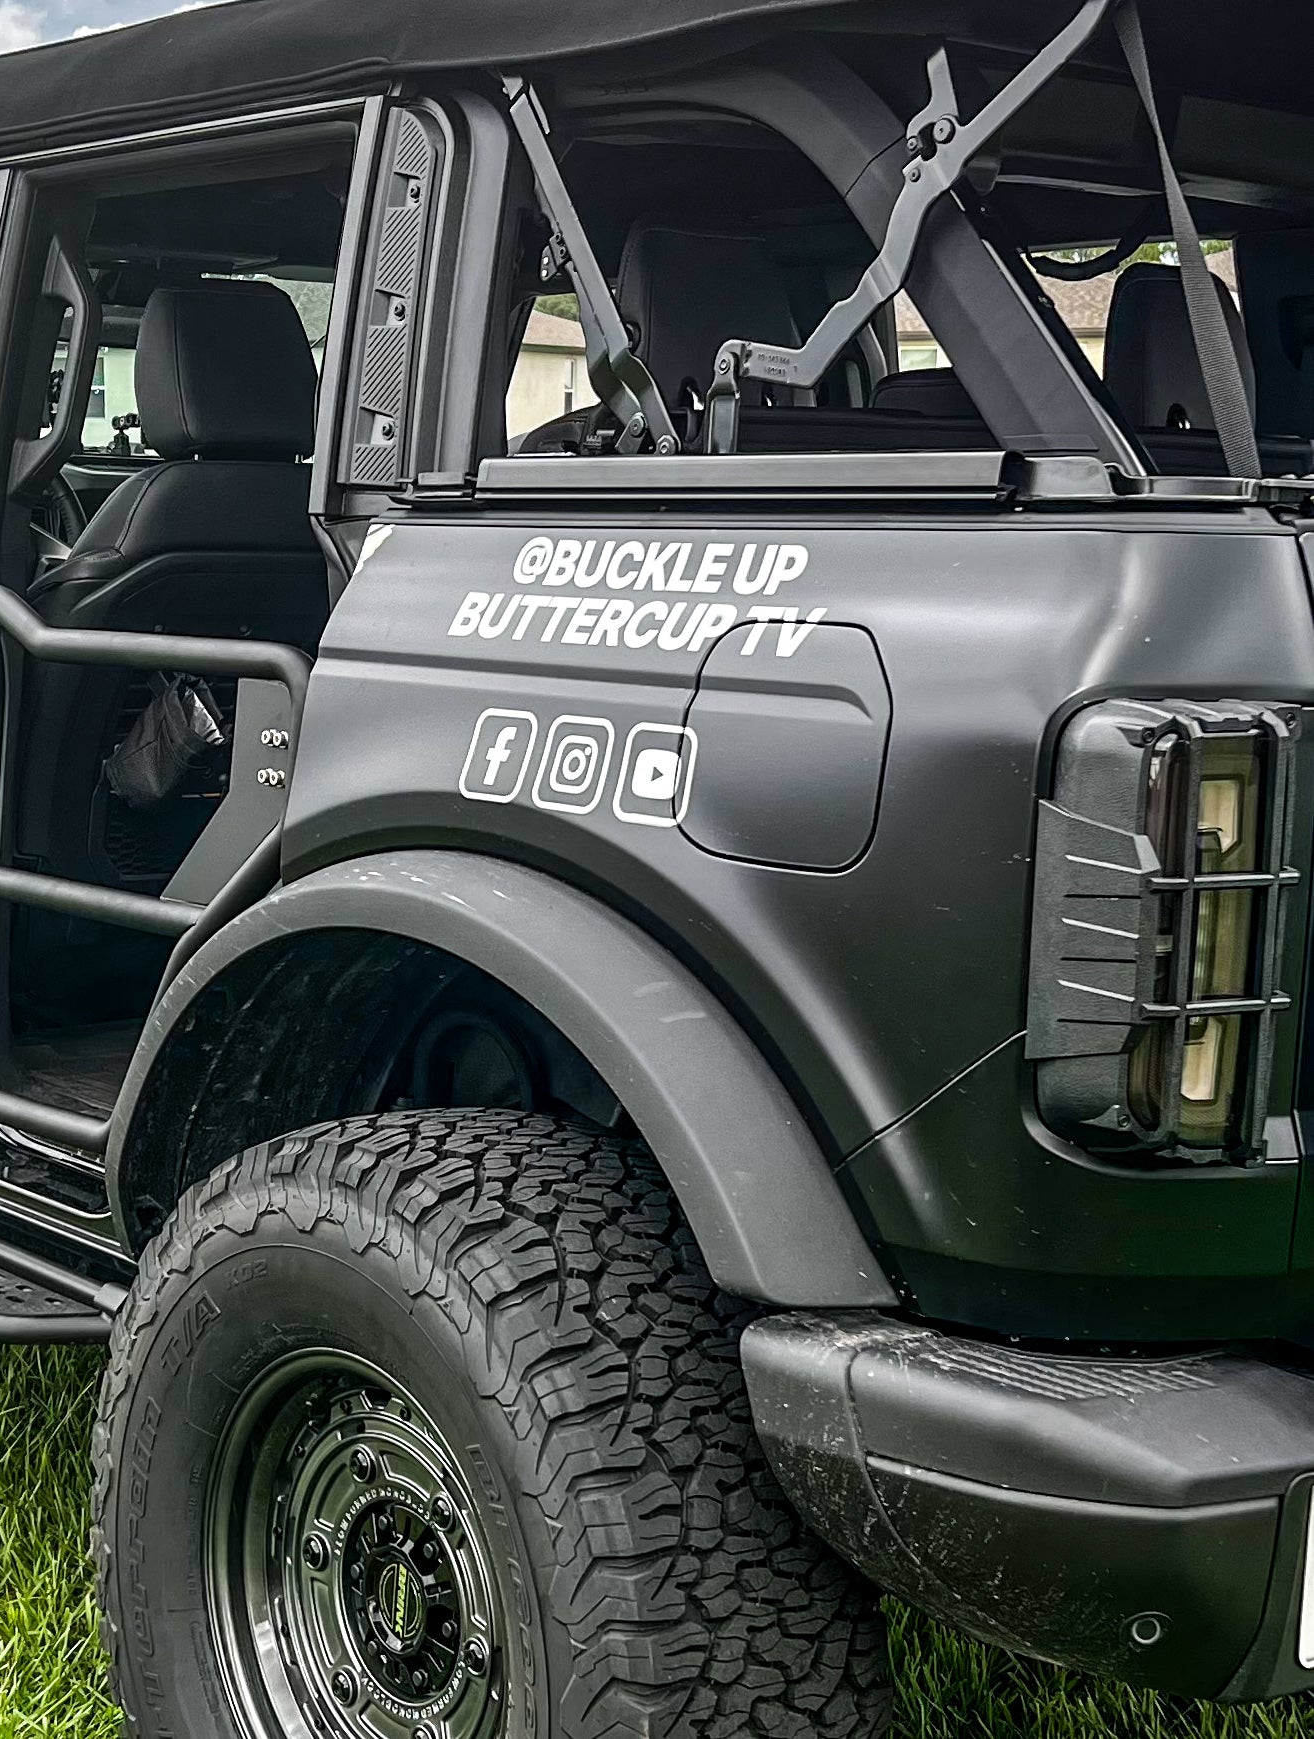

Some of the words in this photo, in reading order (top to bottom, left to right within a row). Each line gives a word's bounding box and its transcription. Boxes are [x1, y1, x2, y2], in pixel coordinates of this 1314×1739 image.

[513, 536, 735, 593] @BUCKLE
[733, 543, 809, 596] UP
[447, 591, 738, 652] BUTTERCUP
[740, 605, 828, 657] TV
